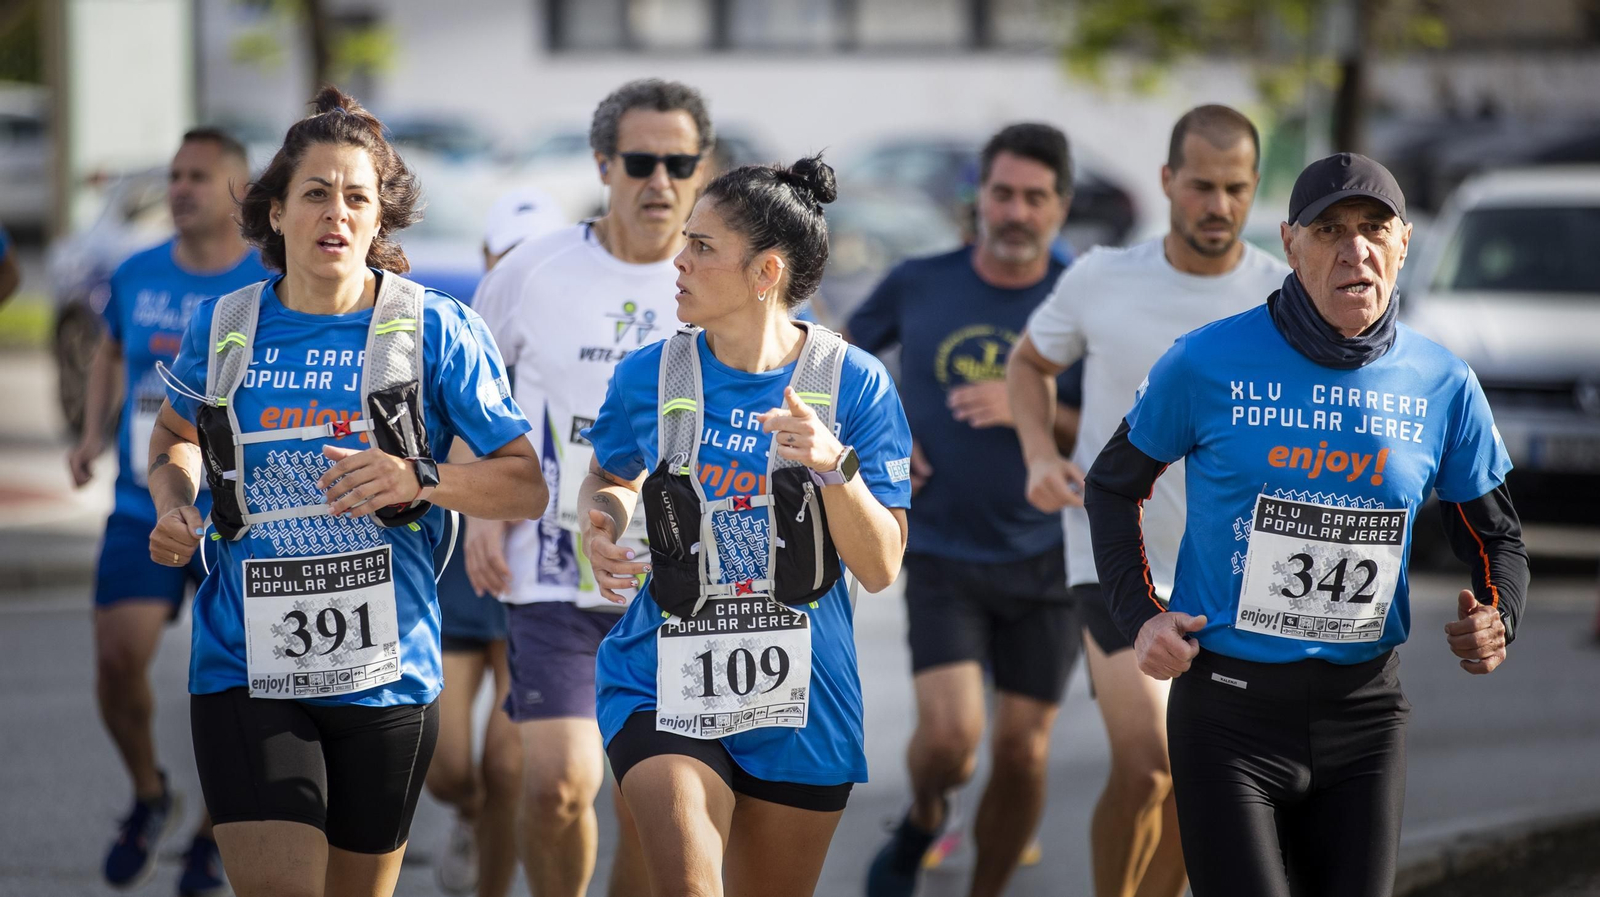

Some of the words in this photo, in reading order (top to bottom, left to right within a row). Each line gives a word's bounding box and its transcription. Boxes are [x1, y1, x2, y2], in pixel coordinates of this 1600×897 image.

[250, 347, 279, 365] LV
[243, 369, 333, 390] OPULAR
[1231, 381, 1282, 401] XLV
[1312, 384, 1428, 417] CARRERA
[1232, 406, 1343, 432] POPULAR
[1354, 414, 1425, 444] JEREZ
[1267, 440, 1390, 486] enjoy!
[1265, 503, 1301, 519] XLV
[1321, 512, 1400, 528] CARRERA
[1262, 517, 1342, 540] POPULAR
[1348, 530, 1398, 542] JEREZ
[251, 566, 283, 579] XLV
[302, 554, 386, 577] CARRERA
[1281, 552, 1379, 604] 342
[252, 578, 327, 594] POPULAR
[335, 568, 387, 588] JEREZ
[283, 601, 379, 658] 391
[668, 617, 739, 634] POPULAR
[747, 614, 802, 629] JEREZ
[1240, 608, 1281, 630] enjoy!
[251, 673, 291, 694] enjoy!
[695, 645, 790, 698] 109
[659, 714, 698, 734] enjoy!
